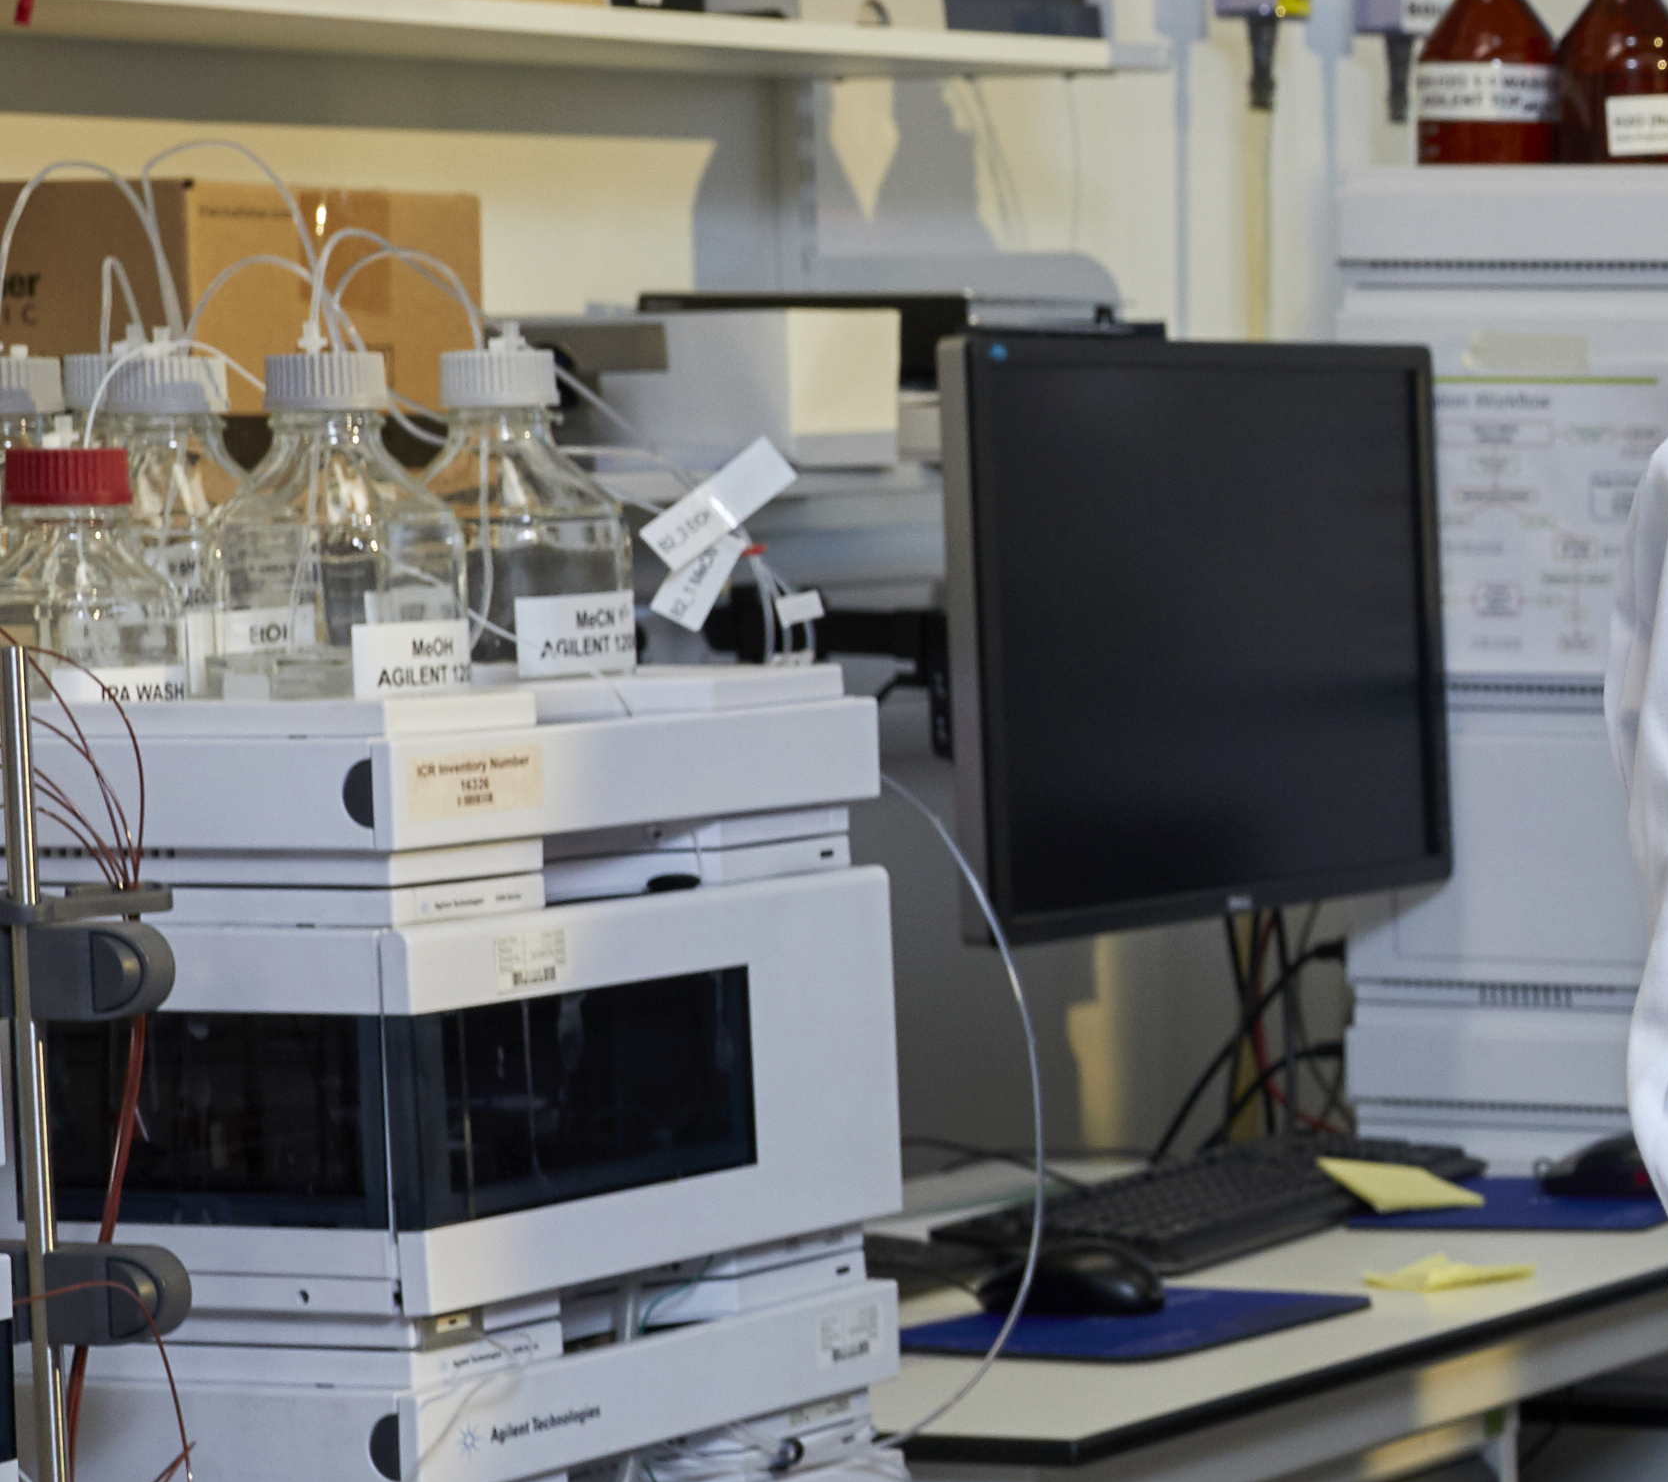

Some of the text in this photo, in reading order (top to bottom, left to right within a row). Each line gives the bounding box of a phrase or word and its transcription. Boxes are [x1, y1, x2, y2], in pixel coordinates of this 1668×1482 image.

[412, 636, 454, 657] MeOH
[540, 636, 610, 659] AGILENT
[378, 666, 450, 688] AGILENT
[136, 682, 185, 702] WASH
[416, 754, 530, 778] ICR Inventory Number
[490, 1405, 601, 1445] Agilent Technologies
